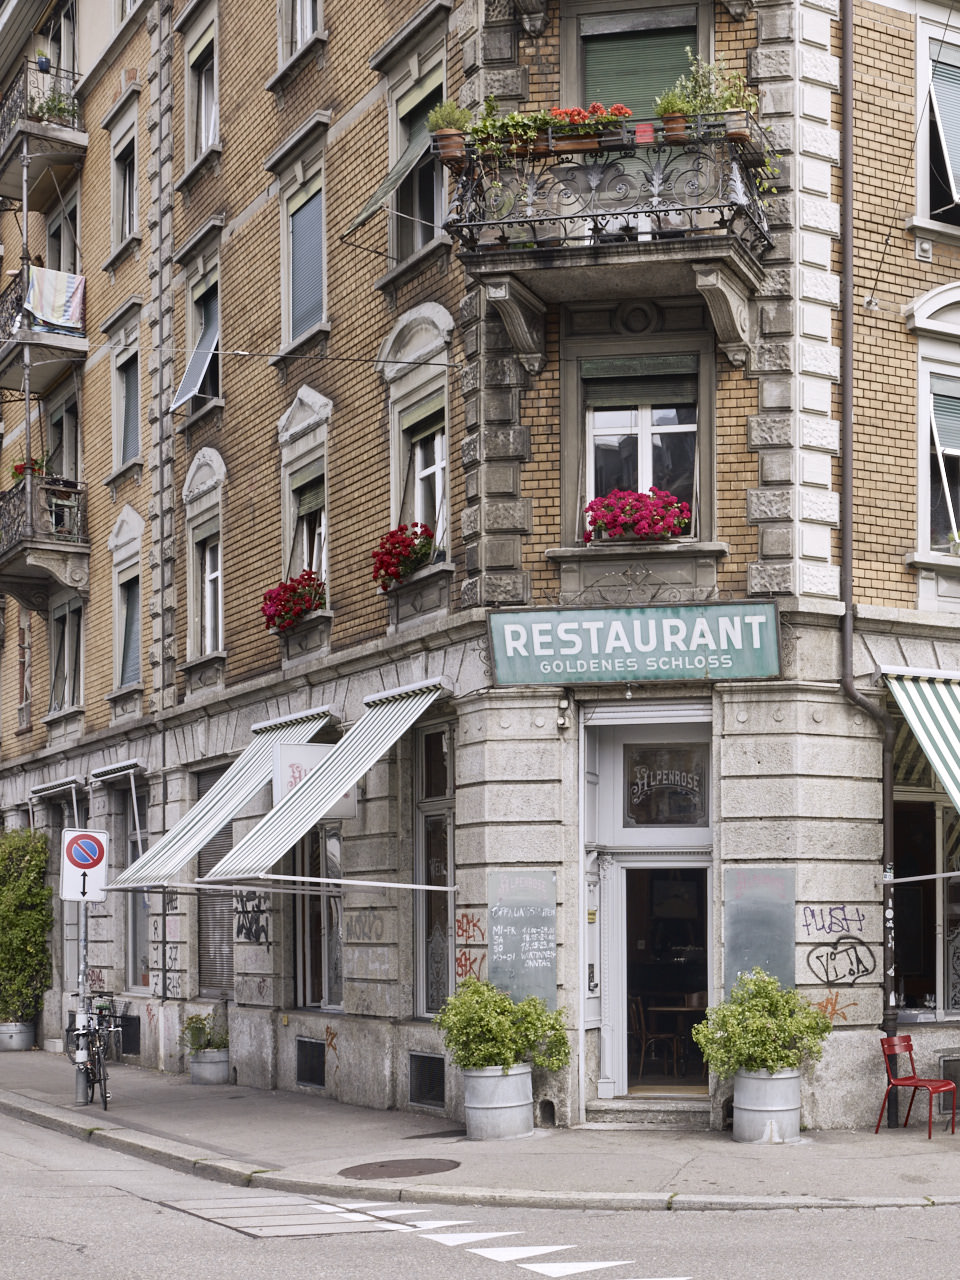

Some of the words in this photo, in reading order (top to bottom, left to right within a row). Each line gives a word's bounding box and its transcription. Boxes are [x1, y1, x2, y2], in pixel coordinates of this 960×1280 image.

[503, 615, 767, 657] RESTAURANT
[540, 658, 638, 674] GOLDENES
[646, 655, 733, 670] SCHLOSS
[631, 765, 699, 799] ALPENROSE
[493, 935, 503, 944] SA
[493, 944, 503, 952] SO
